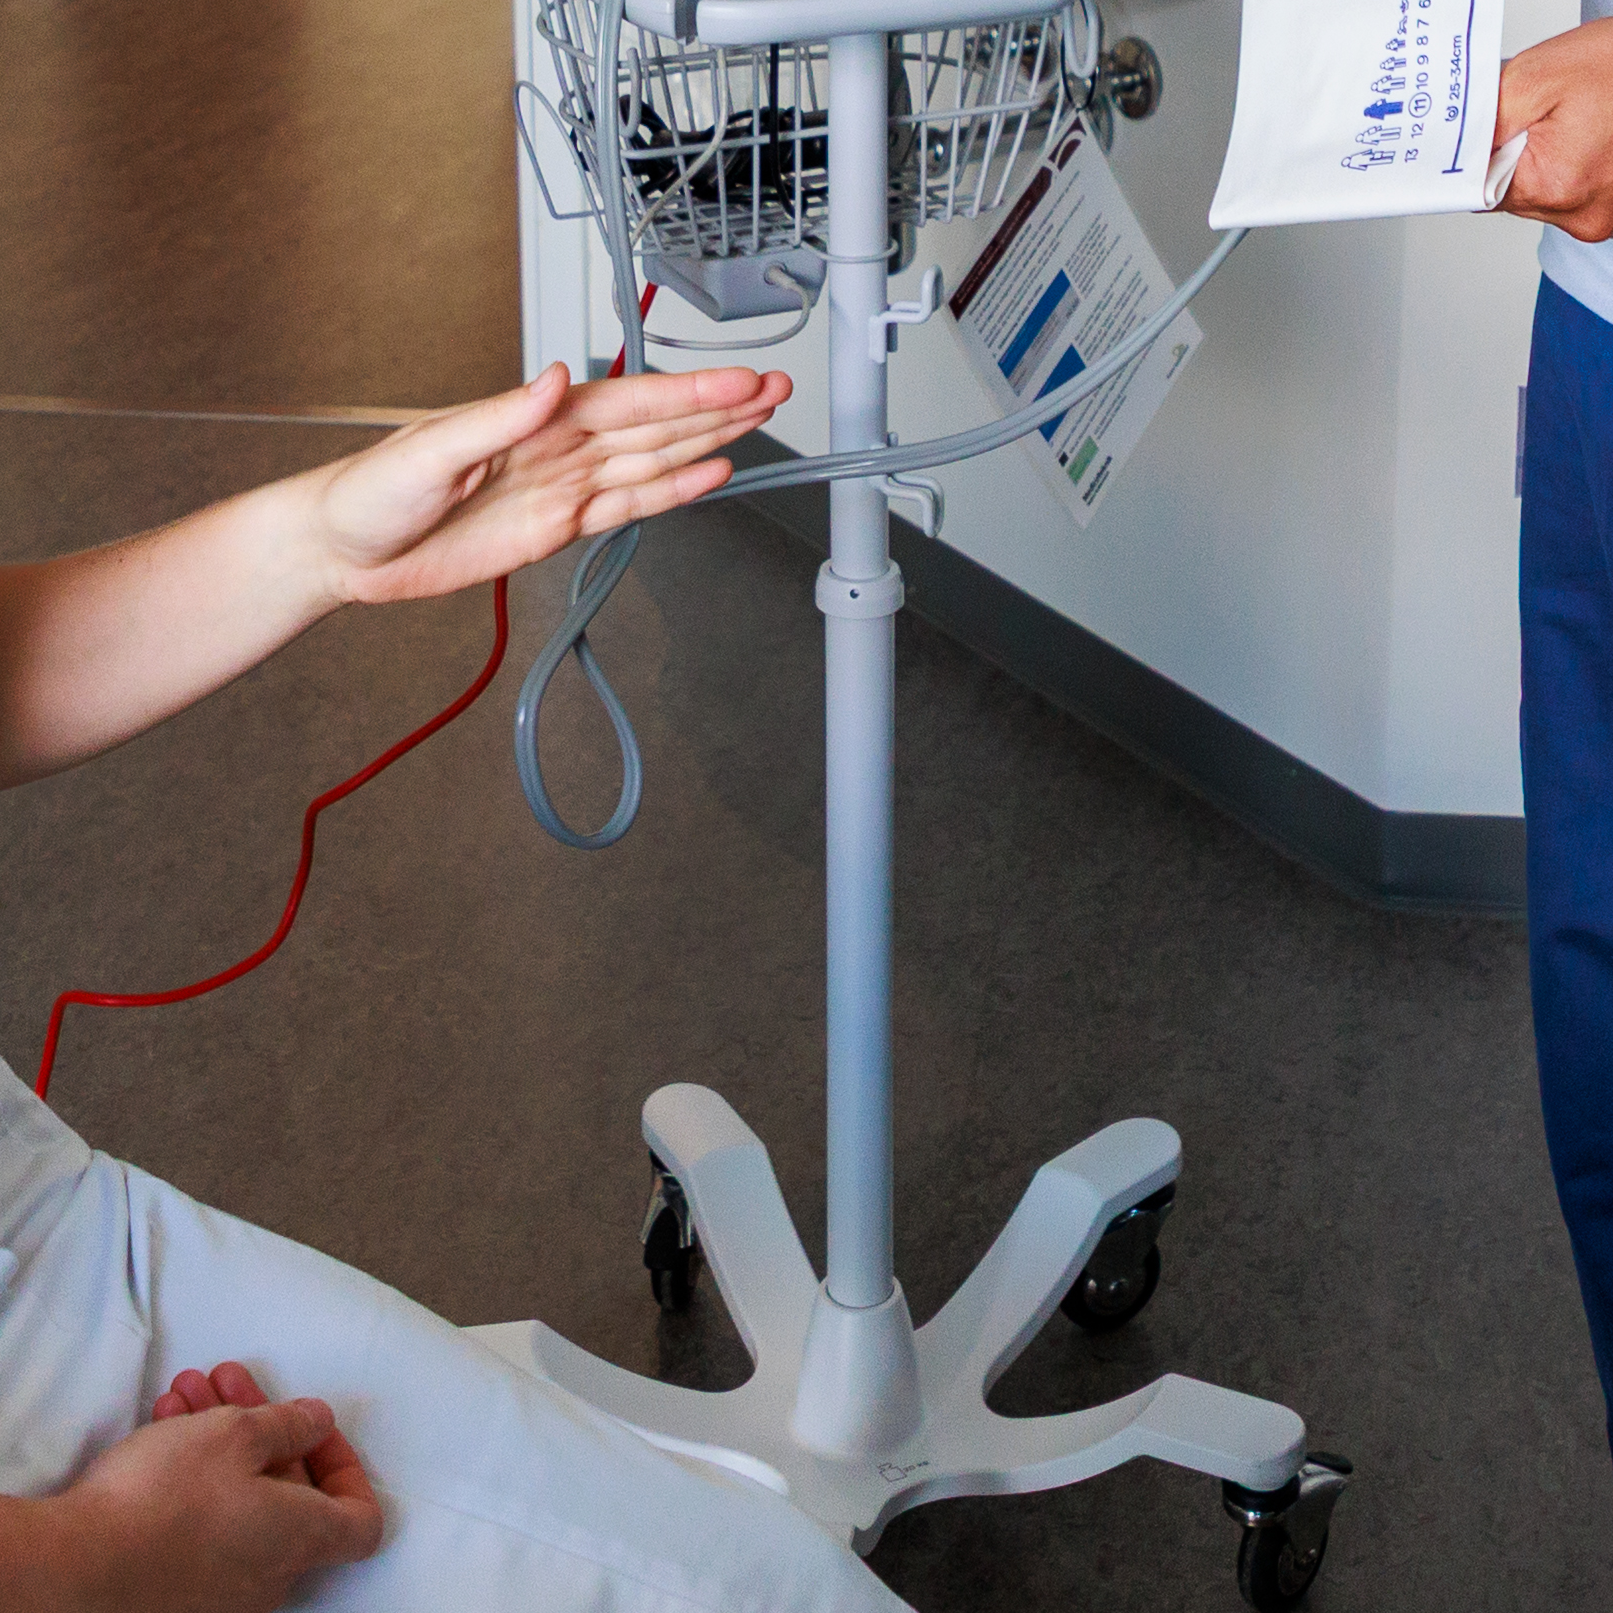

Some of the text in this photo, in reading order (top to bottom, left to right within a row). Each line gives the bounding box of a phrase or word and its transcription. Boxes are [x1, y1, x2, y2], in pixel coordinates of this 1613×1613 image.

[1417, 18, 1430, 29] 7
[1416, 35, 1429, 46] 8
[1417, 54, 1429, 65] 9
[1449, 34, 1462, 100] 25-34cm
[1416, 72, 1429, 90] 10
[1414, 98, 1427, 112] 11
[1411, 123, 1424, 138] 12
[1405, 148, 1419, 163] 13
